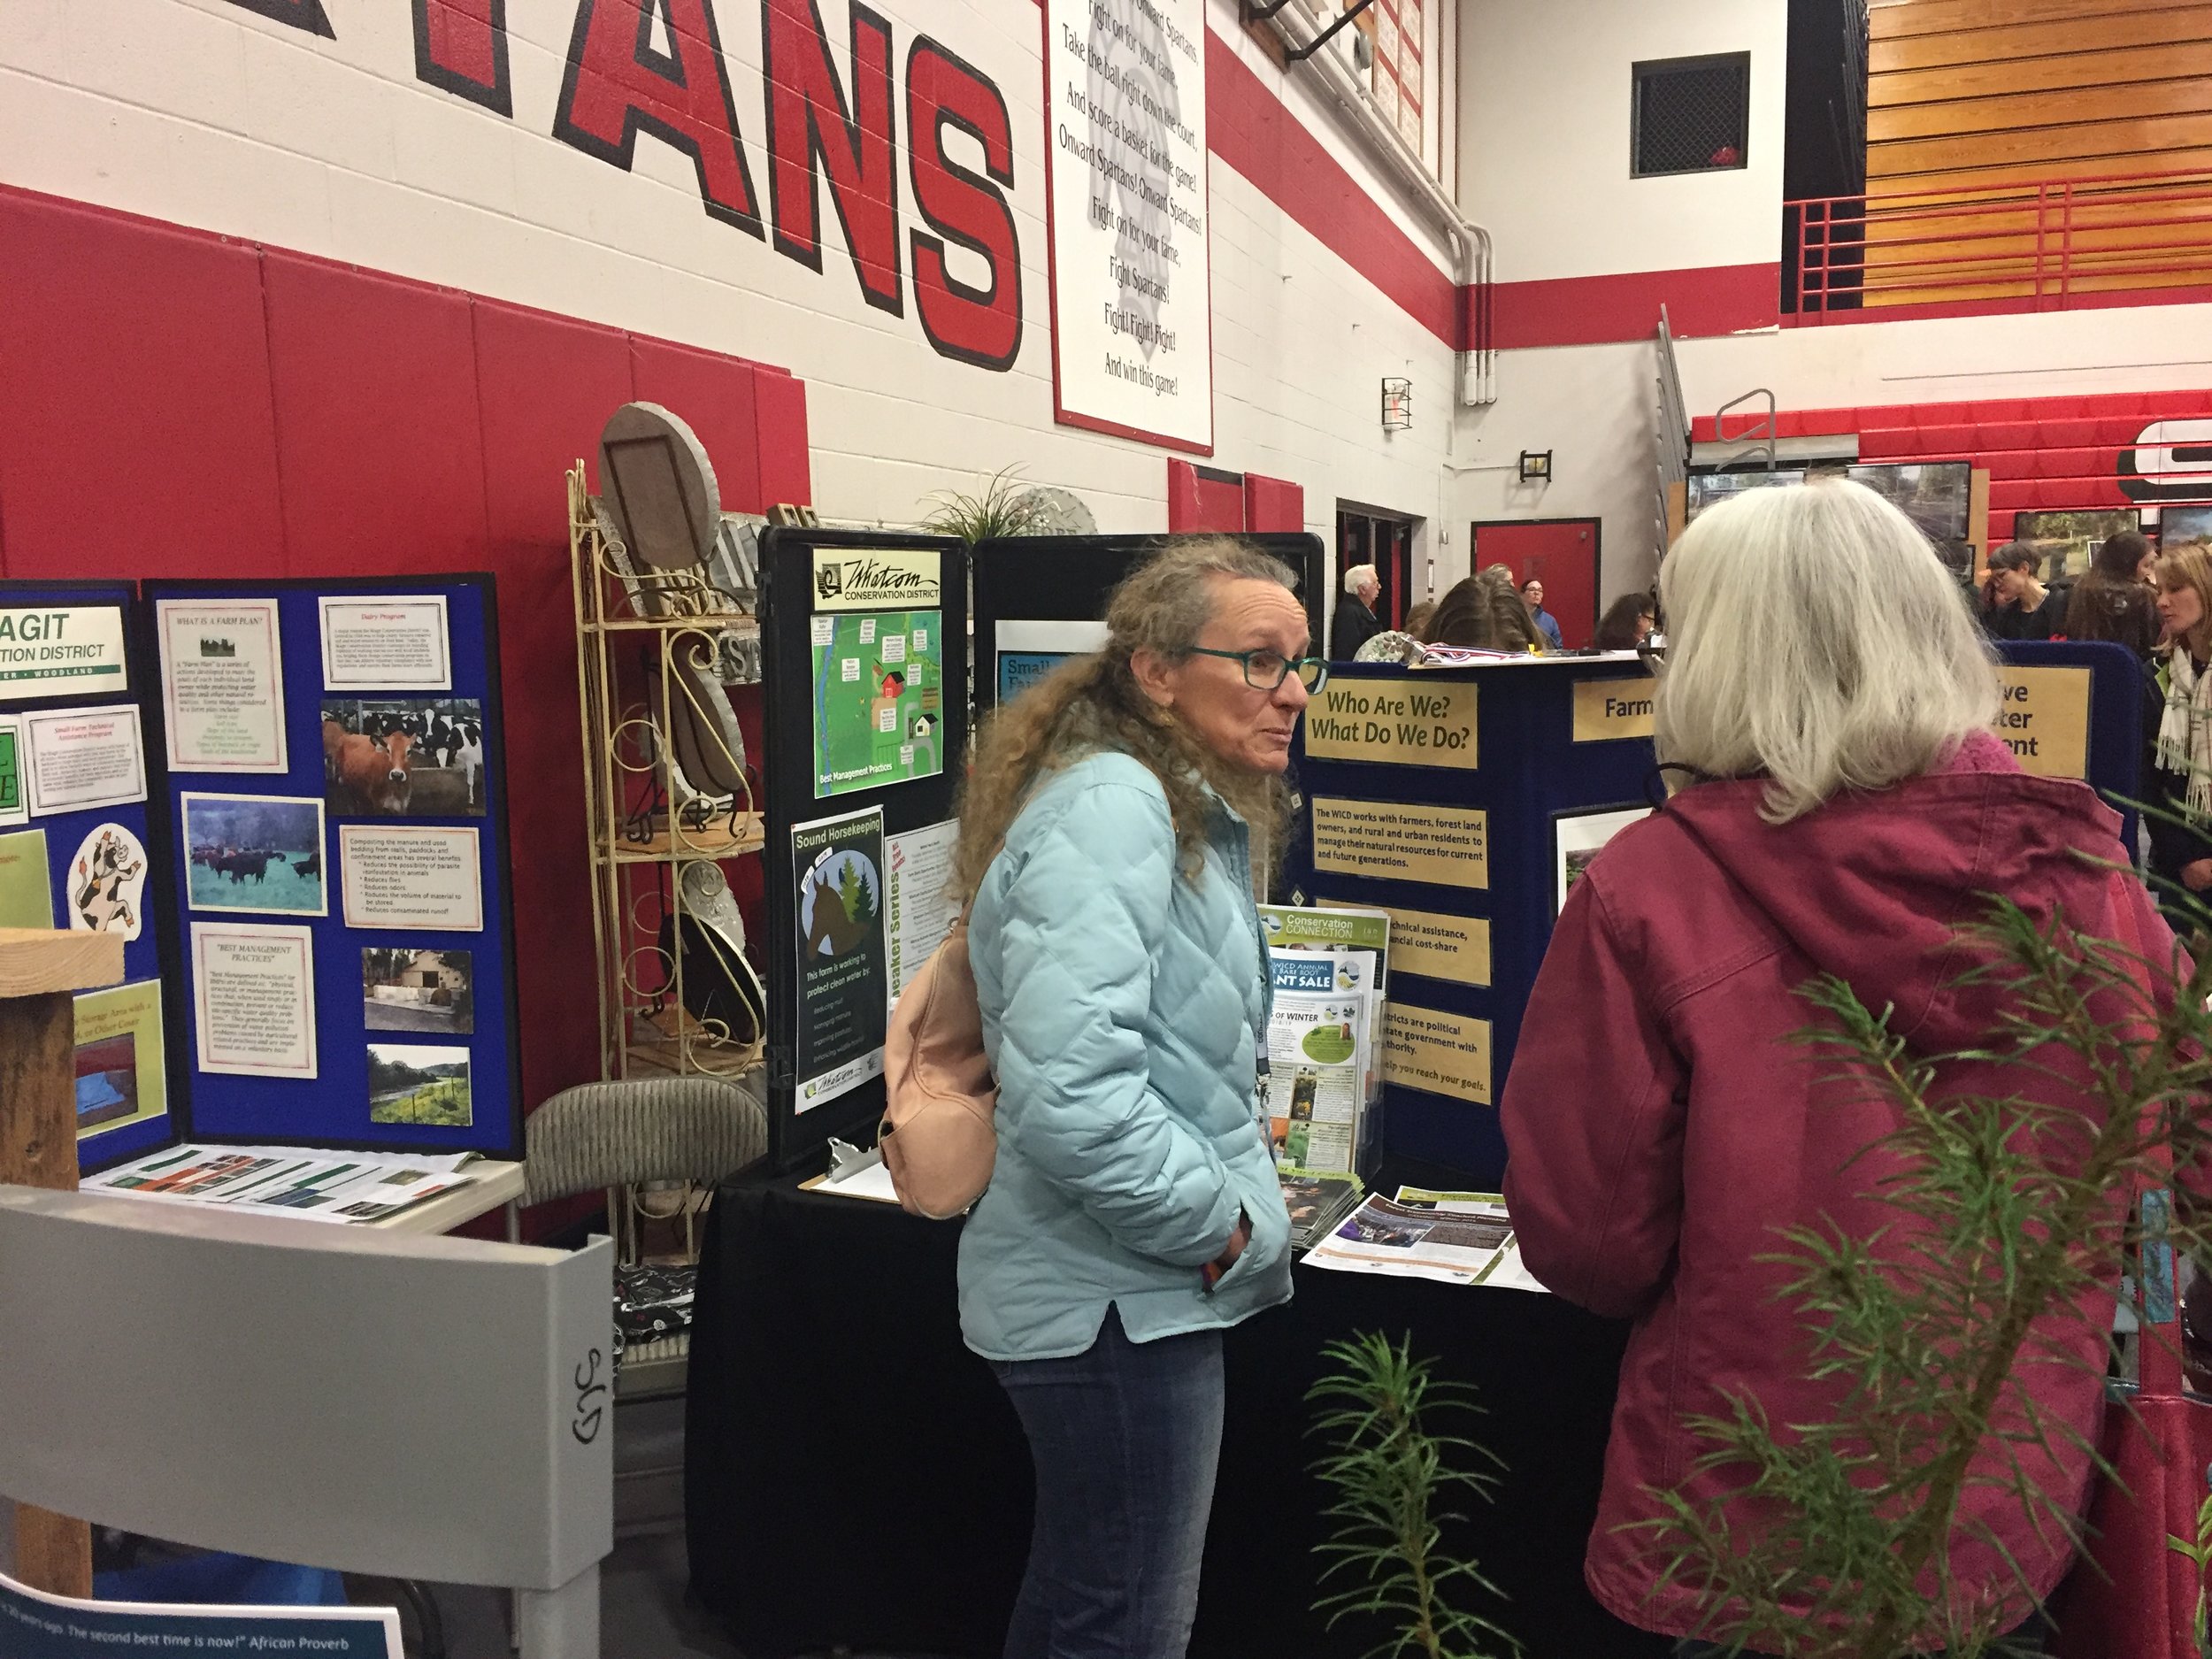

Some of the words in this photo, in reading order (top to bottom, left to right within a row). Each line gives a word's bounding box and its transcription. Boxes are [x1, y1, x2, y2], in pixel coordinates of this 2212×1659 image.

[1088, 0, 1111, 31] Fight
[1112, 16, 1125, 42] on
[1125, 25, 1136, 53] for
[1139, 42, 1156, 68] your
[1157, 52, 1179, 90] fame,
[1063, 22, 1086, 63] Take
[1087, 42, 1102, 75] the
[1104, 55, 1120, 89] ball
[1122, 72, 1141, 107] right
[1142, 88, 1164, 121] down
[1164, 107, 1177, 134] the
[1177, 120, 1198, 153] court,
[1066, 81, 1087, 116] And
[1088, 101, 1113, 134] score
[1114, 119, 1120, 139] a
[1122, 119, 1148, 161] basket
[1149, 141, 1161, 166] for
[1162, 154, 1174, 178] the
[1175, 165, 1197, 194] game!
[1059, 122, 1095, 168] Onward
[1097, 147, 1138, 195] Spartans!
[1139, 176, 1169, 219] Onward
[1170, 196, 1202, 236] Spartans!
[1093, 195, 1115, 231] Fight
[1117, 214, 1127, 240] on
[1129, 216, 1140, 244] for
[1141, 227, 1159, 256] your
[1161, 234, 1181, 269] fame,
[1110, 254, 1131, 288] Fight
[1132, 266, 1170, 305] Spartans!
[1104, 302, 1129, 335] Fight!
[1130, 312, 1154, 345] Fight!
[1155, 323, 1176, 355] Fight!
[1105, 352, 1122, 379] And
[1123, 359, 1138, 384] win
[1139, 365, 1154, 389] this
[1155, 375, 1178, 397] game!
[843, 558, 939, 589] Whatcom
[844, 590, 905, 601] CONSERVATION
[906, 589, 939, 599] DISTRICT
[0, 612, 70, 642] AGIT
[176, 617, 200, 626] WHAT
[200, 617, 208, 626] IS
[216, 617, 238, 626] FARM
[239, 617, 263, 626] PLAN?
[0, 646, 36, 663] TION
[40, 643, 105, 661] DISTRICT
[35, 667, 93, 679] WOODLAND
[1327, 690, 1370, 715] Who
[1373, 695, 1405, 717] Are
[1409, 695, 1451, 719] We?
[1606, 697, 1654, 718] Farm
[1992, 711, 2033, 729] ter
[1311, 718, 1360, 742] What
[1364, 721, 1391, 744] Do
[1396, 723, 1428, 748] We
[1432, 725, 1471, 750] Do?
[819, 772, 833, 785] Best
[833, 766, 869, 782] Management
[869, 763, 893, 775] Practices
[1316, 807, 1331, 818] The
[1331, 809, 1352, 820] WICD
[1353, 811, 1378, 823] works
[1379, 813, 1397, 825] with
[1399, 814, 1434, 828] farmers,
[1435, 818, 1462, 830] forest
[1463, 820, 1482, 832] land
[796, 829, 826, 849] Sound
[828, 818, 880, 841] Horsekeeping
[1317, 824, 1347, 835] owners,
[1348, 825, 1363, 835] and
[1364, 826, 1385, 837] rural
[1386, 828, 1402, 839] and
[1404, 830, 1429, 841] urban
[1431, 833, 1471, 845] residents
[1472, 836, 1483, 847] to
[1317, 837, 1347, 849] manage
[1347, 837, 1365, 849] their
[1365, 841, 1395, 852] natural
[1395, 844, 1436, 856] resources
[1437, 847, 1449, 858] for
[1450, 849, 1483, 862] current
[1317, 849, 1332, 859] and
[1333, 850, 1357, 862] future
[1358, 853, 1409, 868] generations.
[890, 872, 901, 933] Series
[1286, 914, 1354, 930] Conservation
[1286, 925, 1354, 940] CONNECTION
[1421, 926, 1469, 942] assistance,
[231, 953, 276, 964] PRACTICES"
[238, 944, 293, 955] MANAGEMENT
[1415, 939, 1458, 954] cost-share
[806, 970, 818, 982] This
[833, 963, 839, 972] is
[839, 956, 860, 971] working
[806, 981, 830, 1001] protect
[830, 976, 846, 990] clean
[1298, 976, 1332, 988] SALE
[1286, 1012, 1319, 1023] WINTER
[1410, 1019, 1425, 1029] are
[1425, 1021, 1462, 1036] political
[1404, 1031, 1456, 1050] government
[1457, 1042, 1478, 1055] with
[1399, 1063, 1415, 1075] you
[1416, 1067, 1439, 1081] reach
[1440, 1073, 1460, 1086] your
[1460, 1076, 1487, 1093] goals.
[89, 1630, 132, 1645] second
[133, 1632, 160, 1647] best
[162, 1634, 192, 1647] time
[194, 1634, 204, 1647] is
[207, 1634, 246, 1648] now!"
[249, 1635, 296, 1651] African
[298, 1636, 350, 1651] Proverb
